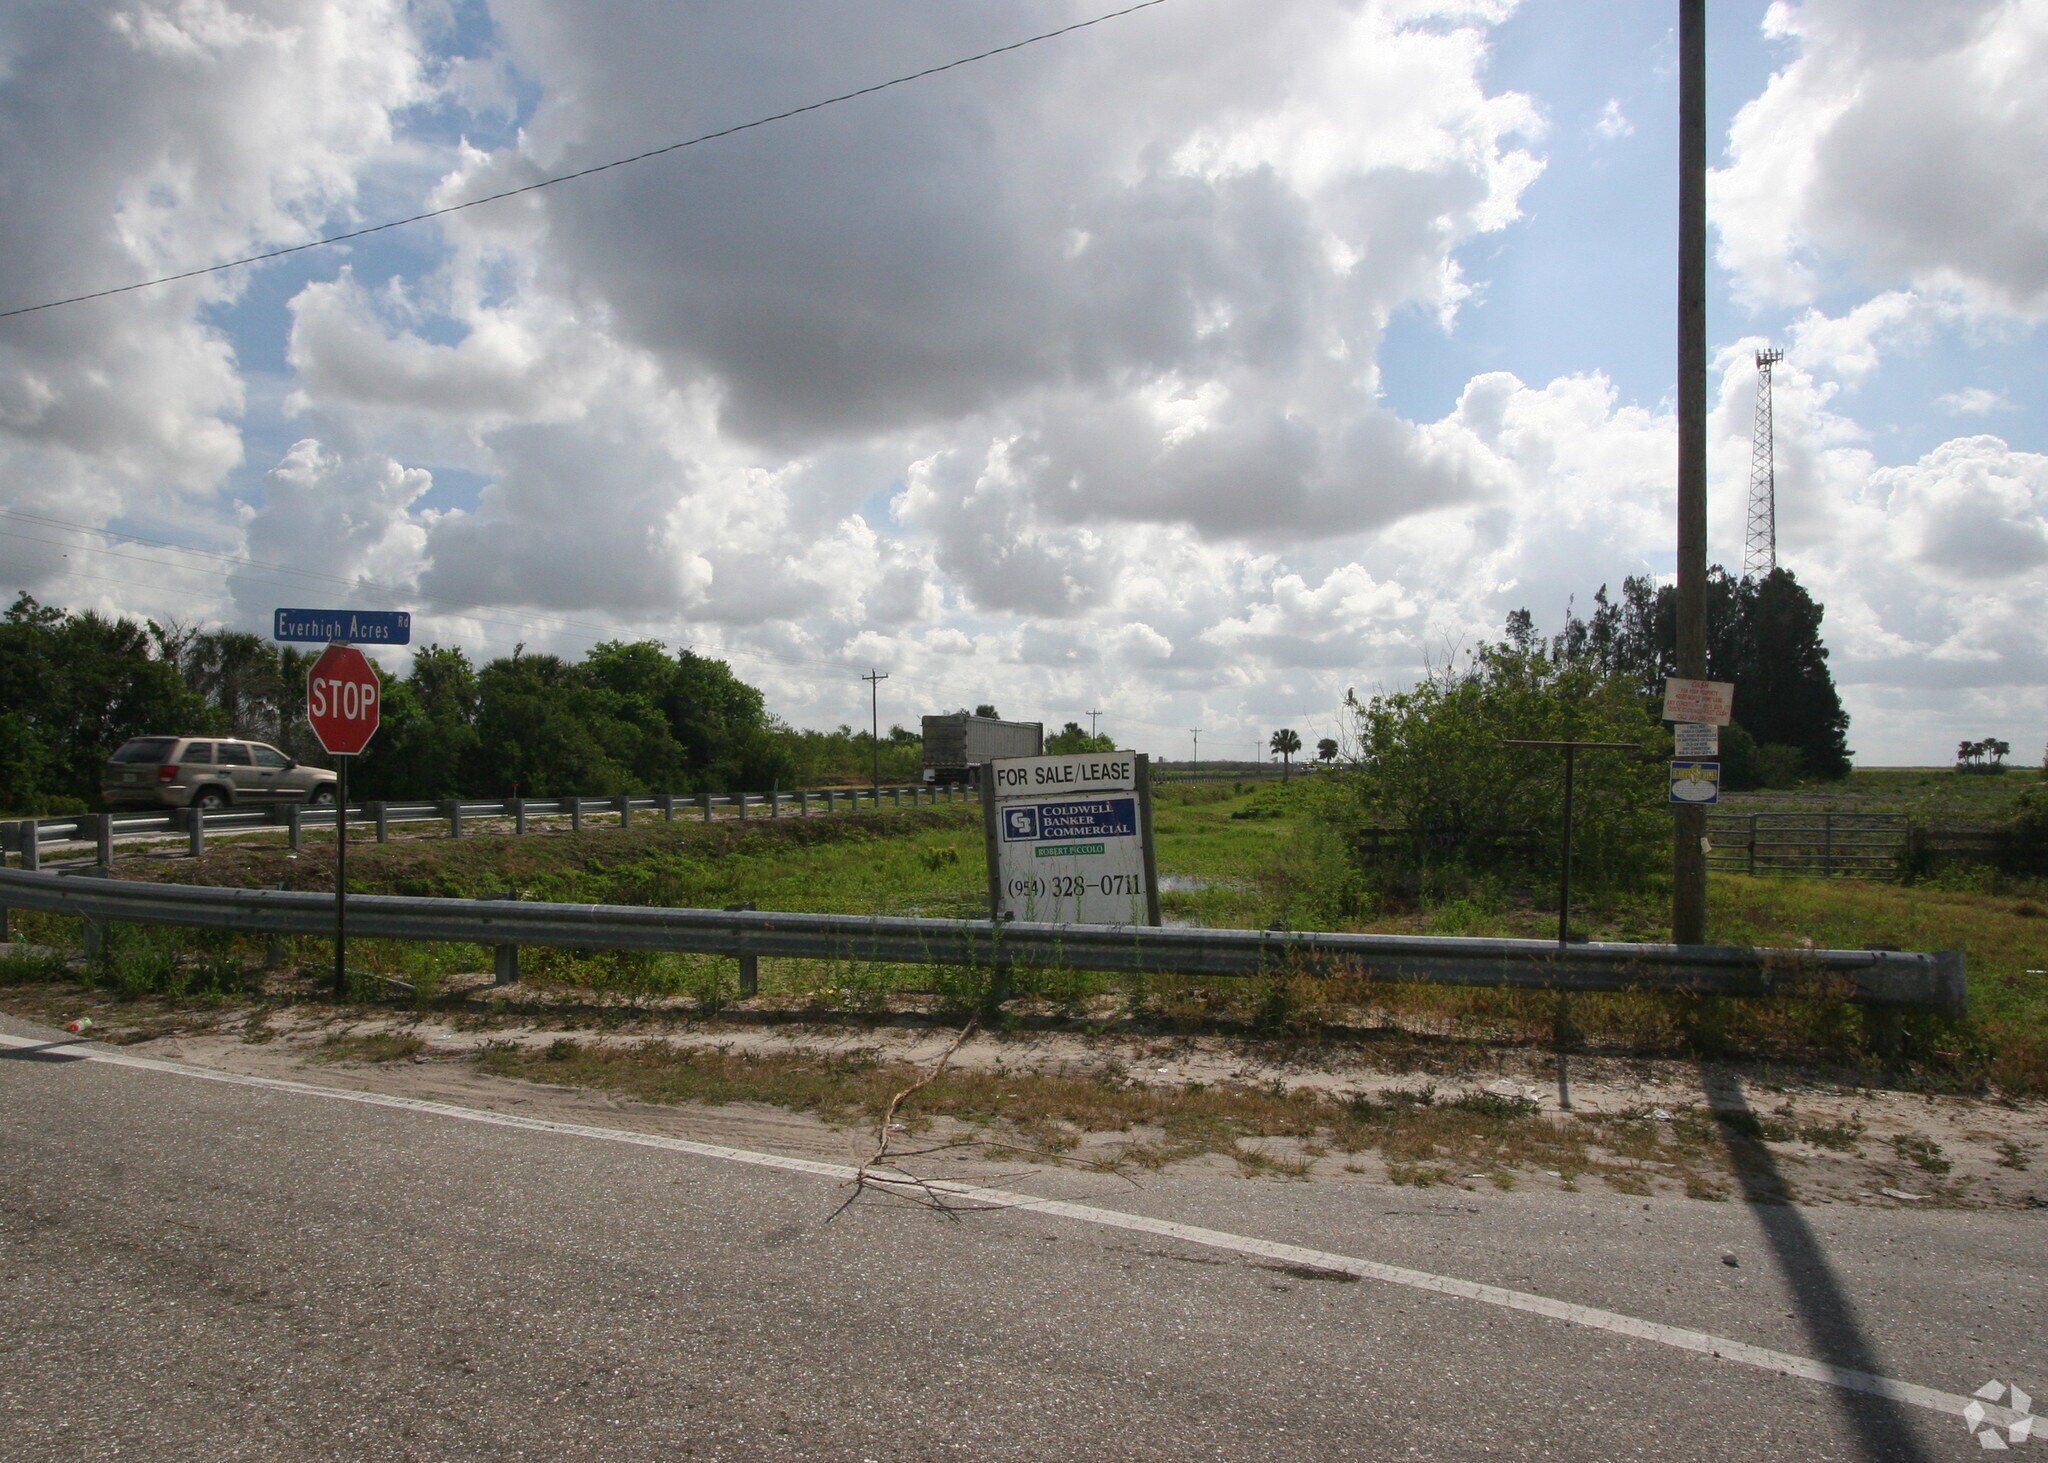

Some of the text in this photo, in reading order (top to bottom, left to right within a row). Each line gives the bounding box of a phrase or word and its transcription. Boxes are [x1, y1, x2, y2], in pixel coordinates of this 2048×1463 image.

[279, 612, 409, 642] Everhigh Acres Rd
[312, 677, 376, 721] STOP
[997, 762, 1130, 786] FOR SALE/LEASE
[1042, 804, 1114, 816] COLDWELL
[1043, 815, 1095, 826] BANKER
[1044, 825, 1131, 837] COMMERCIAL
[1038, 846, 1067, 856] ROBERT
[1008, 874, 1141, 899] (954) 328-0711
